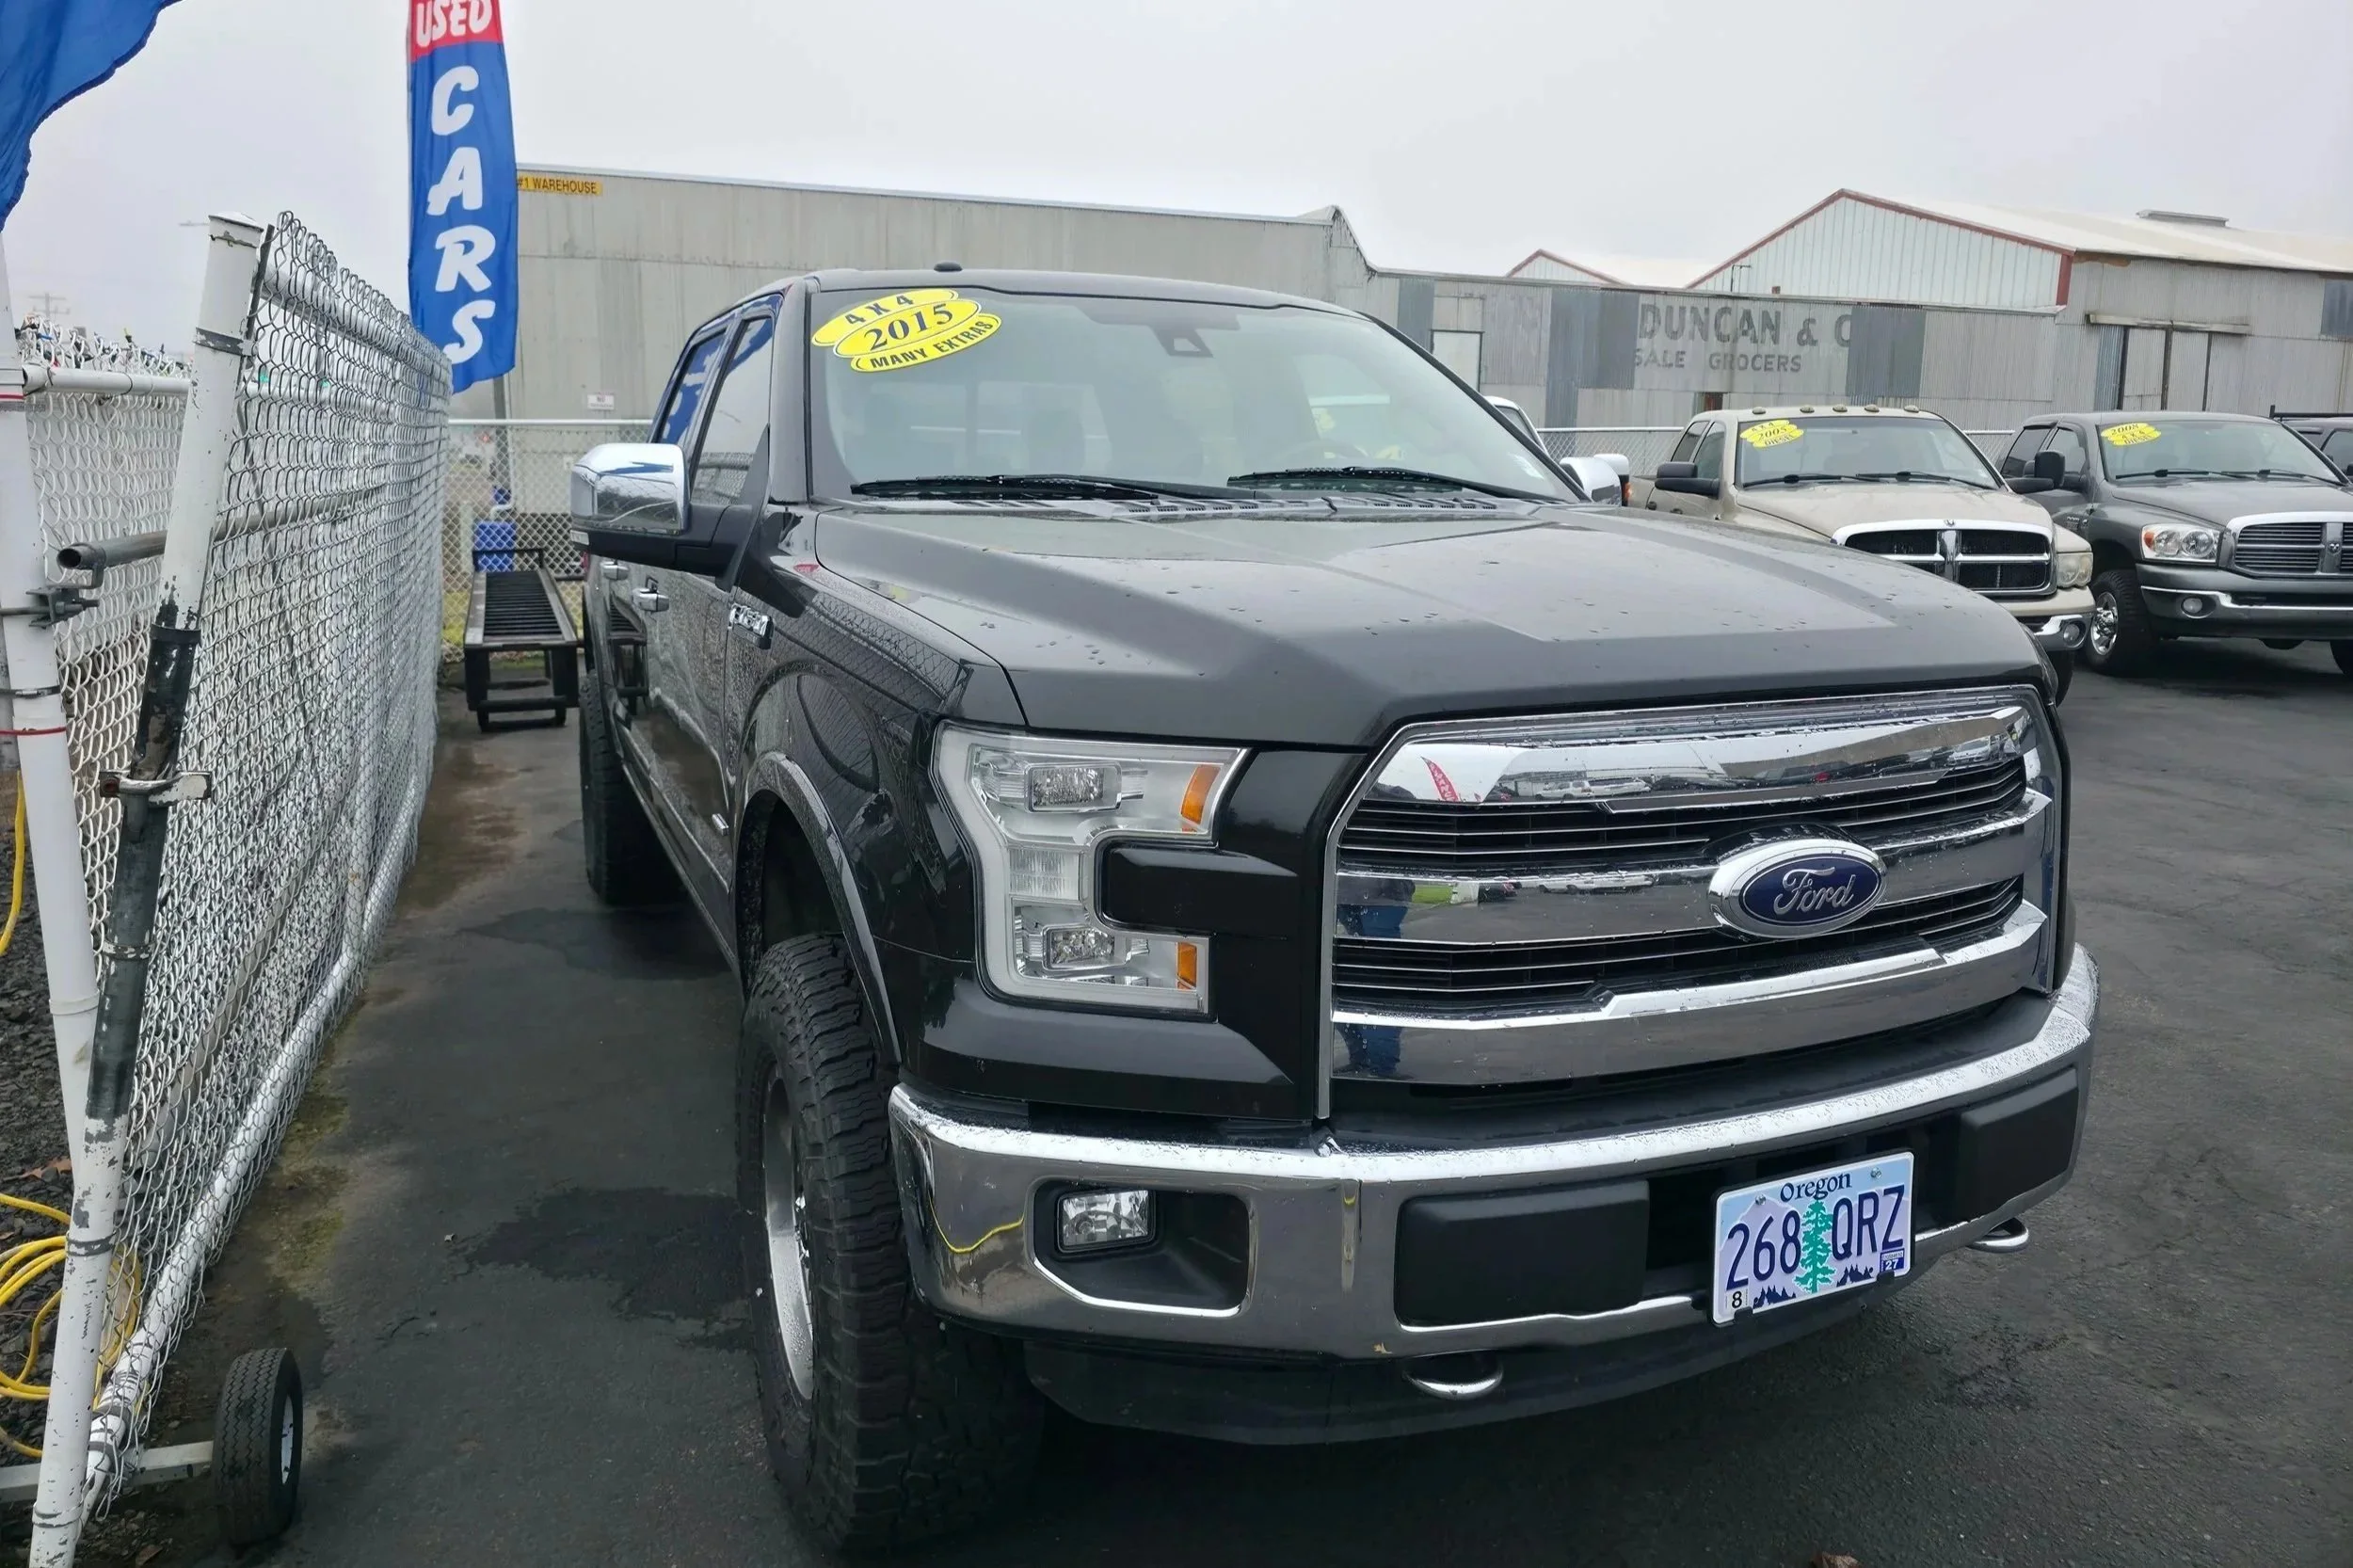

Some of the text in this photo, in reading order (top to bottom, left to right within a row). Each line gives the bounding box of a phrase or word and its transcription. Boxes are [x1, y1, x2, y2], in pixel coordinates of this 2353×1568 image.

[416, 0, 492, 47] USED
[533, 177, 597, 194] WAREHOUSE
[426, 66, 496, 364] CARS
[864, 303, 953, 350] 2015
[870, 321, 994, 368] MANY EXTRAS
[1639, 303, 1781, 345] DUNCAN
[1797, 318, 1818, 346] &
[1634, 347, 1801, 373] SALE GROCERS
[1758, 426, 1787, 440] 2005
[1773, 866, 1857, 915] Ford
[1780, 1172, 1852, 1202] Oregon
[1726, 1185, 1905, 1290] 268 QRZ
[1885, 1258, 1899, 1271] 27
[1732, 1290, 1743, 1309] 8
